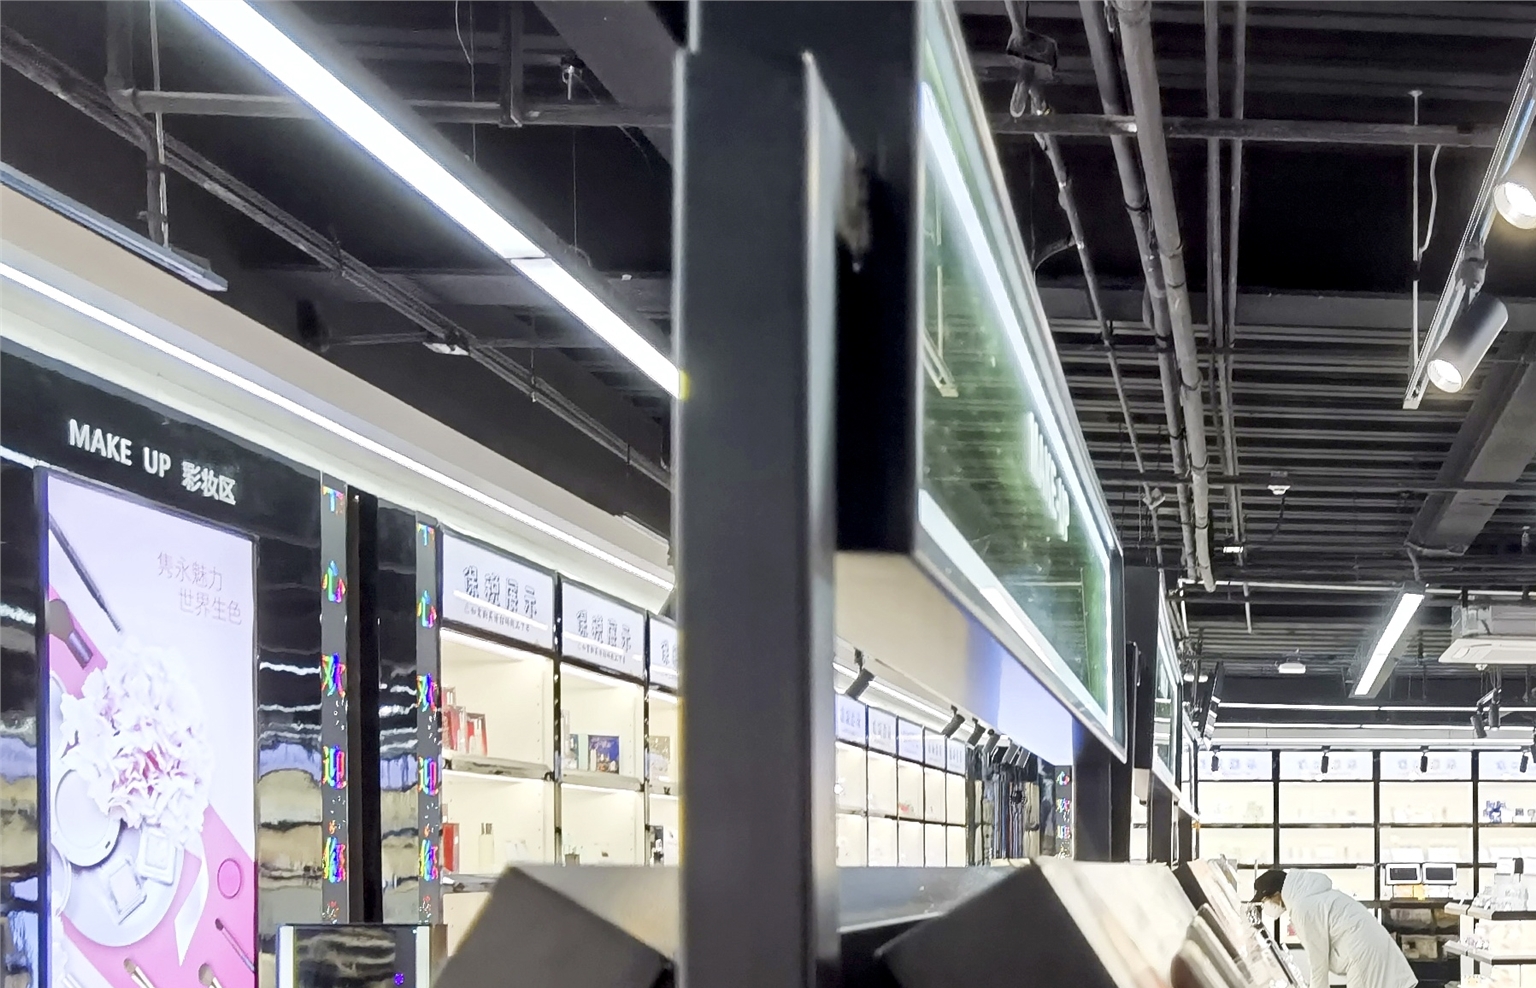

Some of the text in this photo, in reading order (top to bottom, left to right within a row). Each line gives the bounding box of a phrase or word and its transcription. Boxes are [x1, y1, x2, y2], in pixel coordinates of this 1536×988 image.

[68, 418, 236, 505] MAKE UP 彩妆区
[157, 552, 223, 592] 隽永魅力
[178, 587, 242, 626] 世界生色
